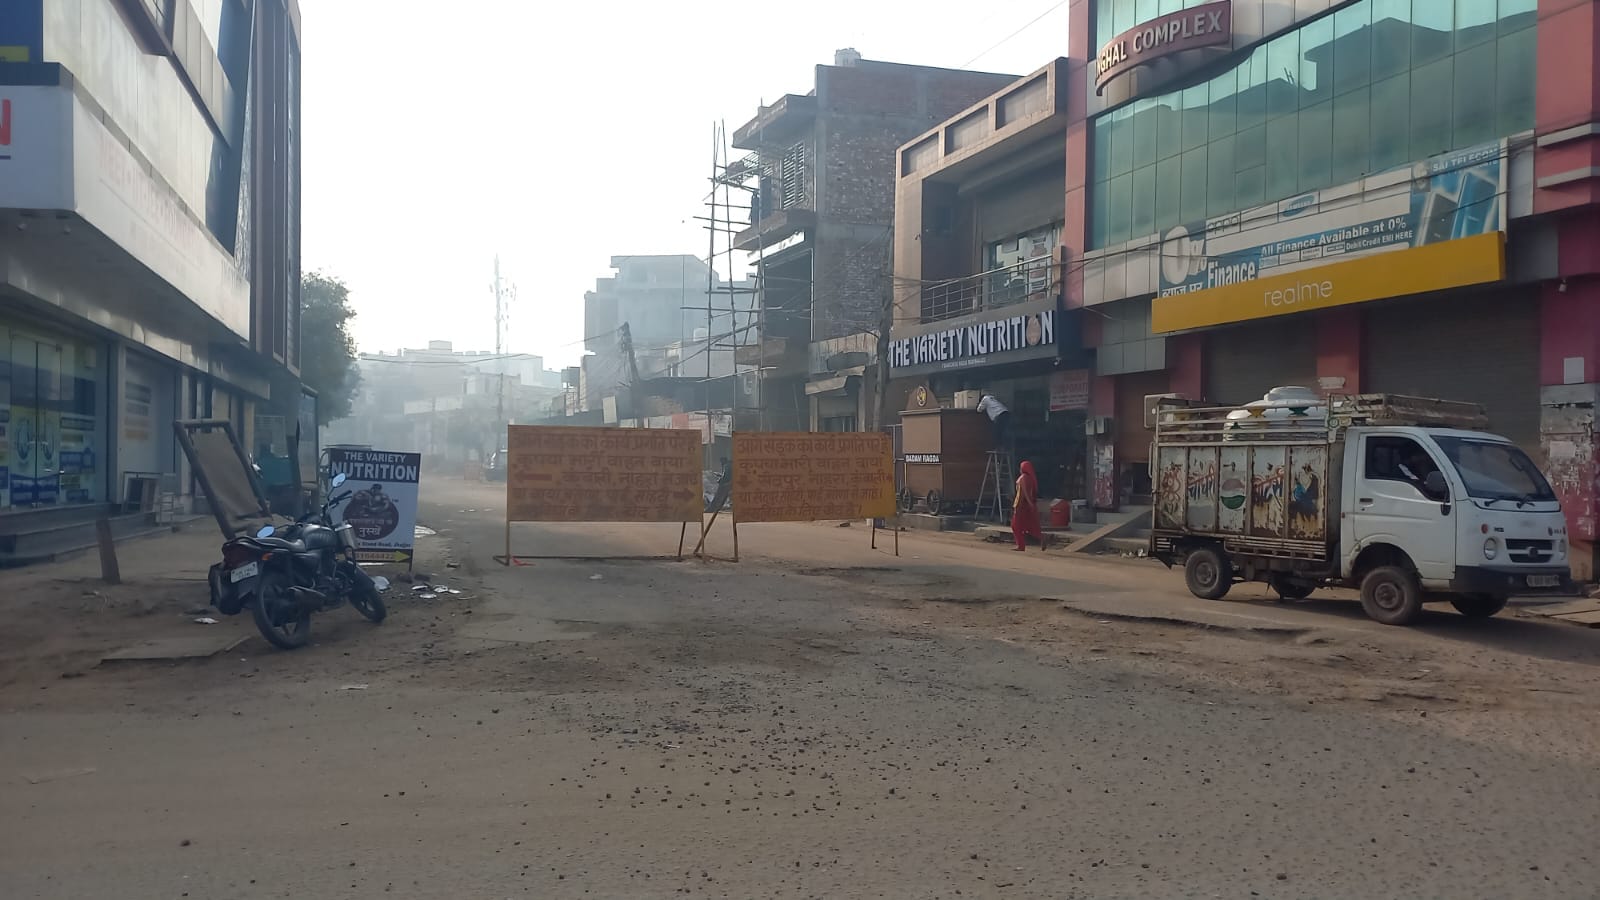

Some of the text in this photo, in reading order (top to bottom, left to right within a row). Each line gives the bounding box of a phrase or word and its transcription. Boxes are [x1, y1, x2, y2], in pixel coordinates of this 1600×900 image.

[1132, 10, 1222, 53] COMPLEX
[1261, 245, 1274, 257] All
[1276, 238, 1317, 252] Finance
[1319, 225, 1370, 246] Available
[1372, 221, 1385, 233] at
[1388, 217, 1407, 231] 0%
[1395, 230, 1414, 241] HERE
[1207, 259, 1256, 290] Finance
[1264, 280, 1333, 306] realme
[888, 338, 910, 368] THE
[912, 327, 964, 364] VARIETY
[331, 461, 417, 481] NUTRITION
[344, 451, 407, 463] THE VARIETY
